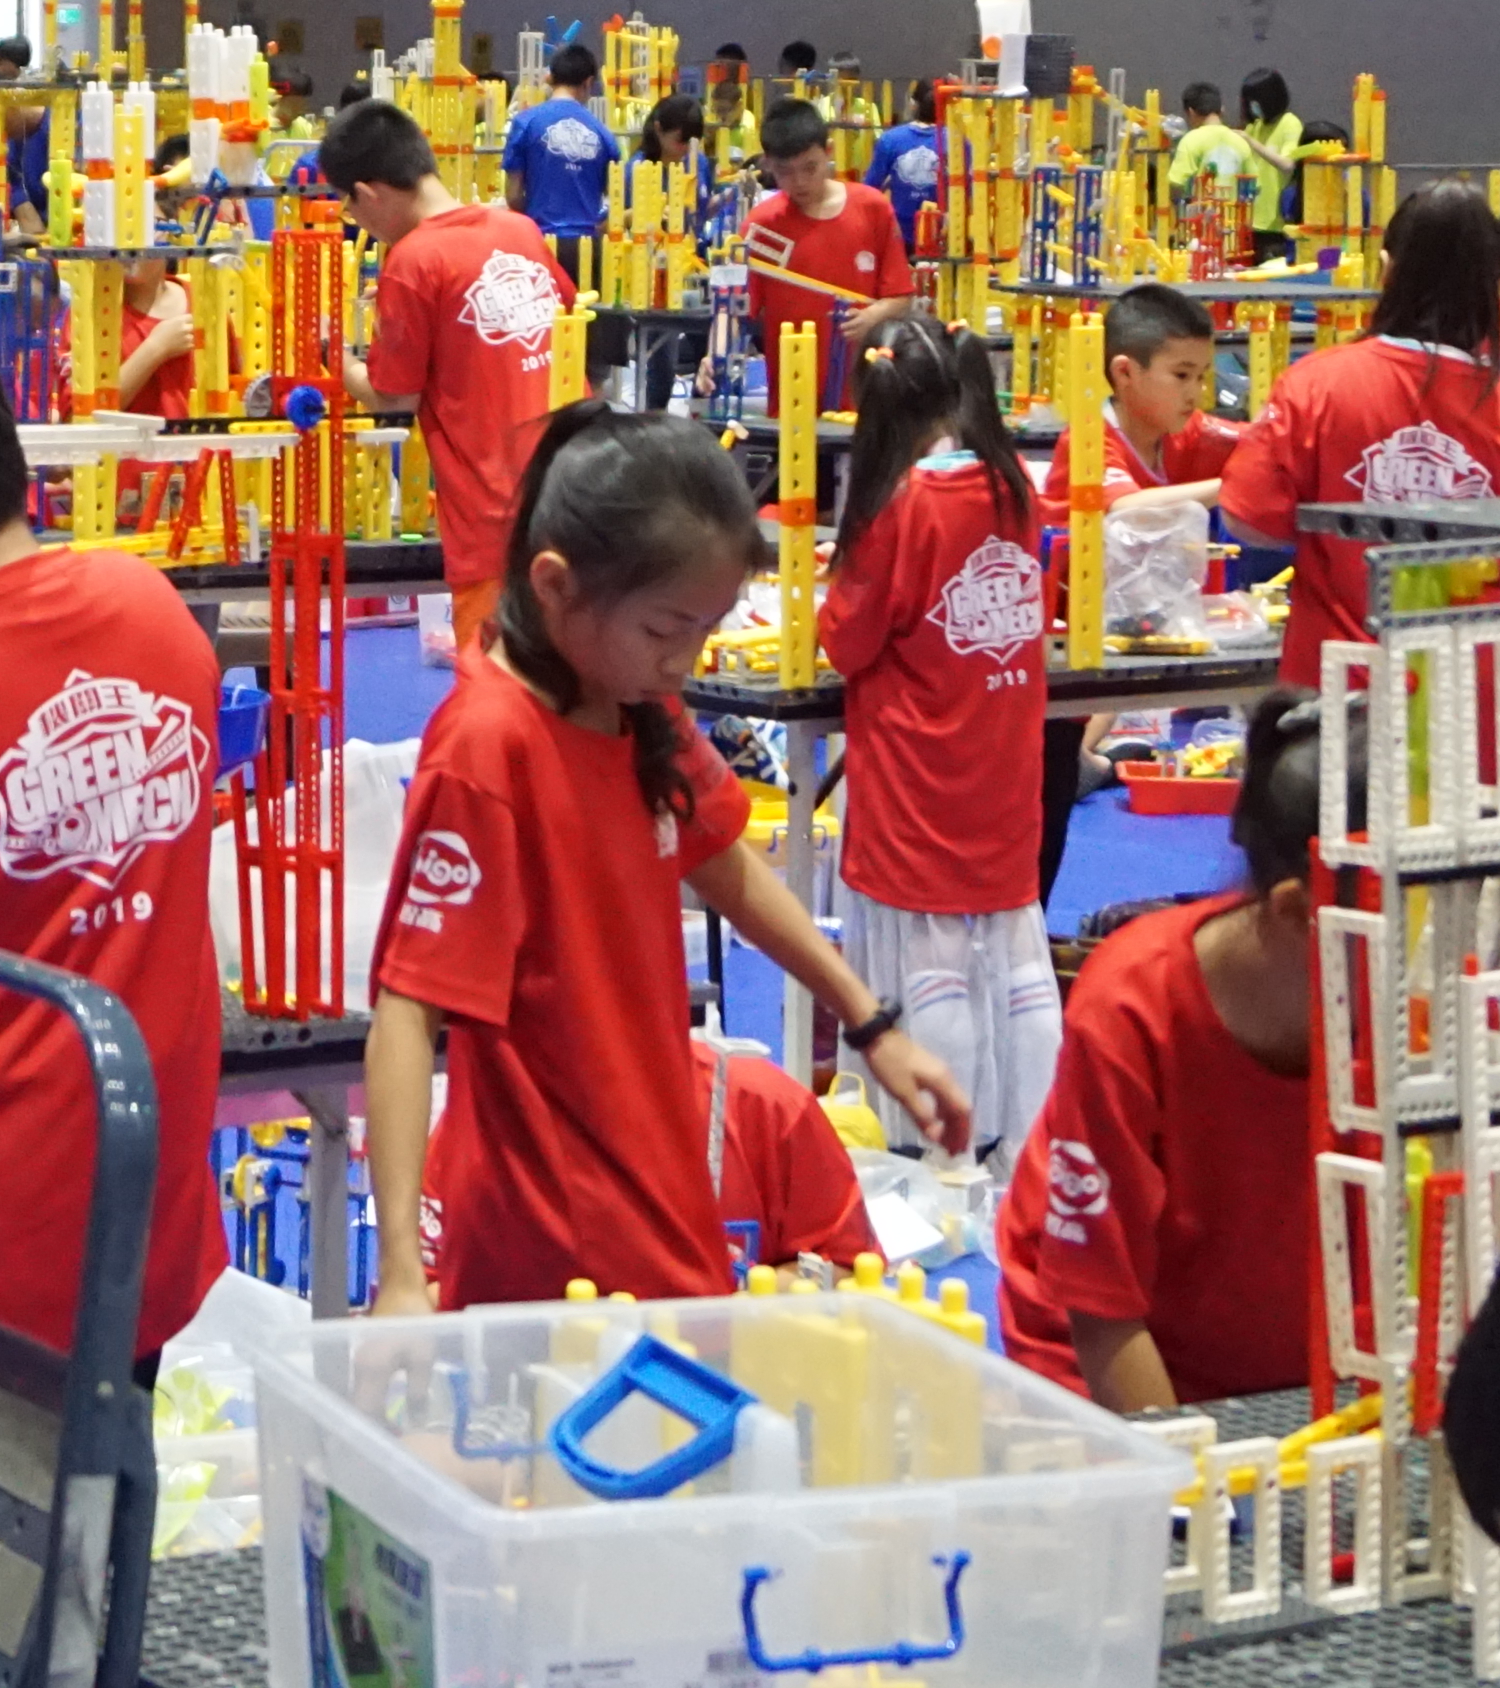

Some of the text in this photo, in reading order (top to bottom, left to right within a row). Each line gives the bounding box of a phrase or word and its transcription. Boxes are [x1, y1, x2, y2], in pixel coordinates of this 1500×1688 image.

[1372, 455, 1455, 496] GREEN
[5, 728, 148, 824] GREEN
[86, 768, 193, 852] MECH
[69, 890, 154, 935] 2019
